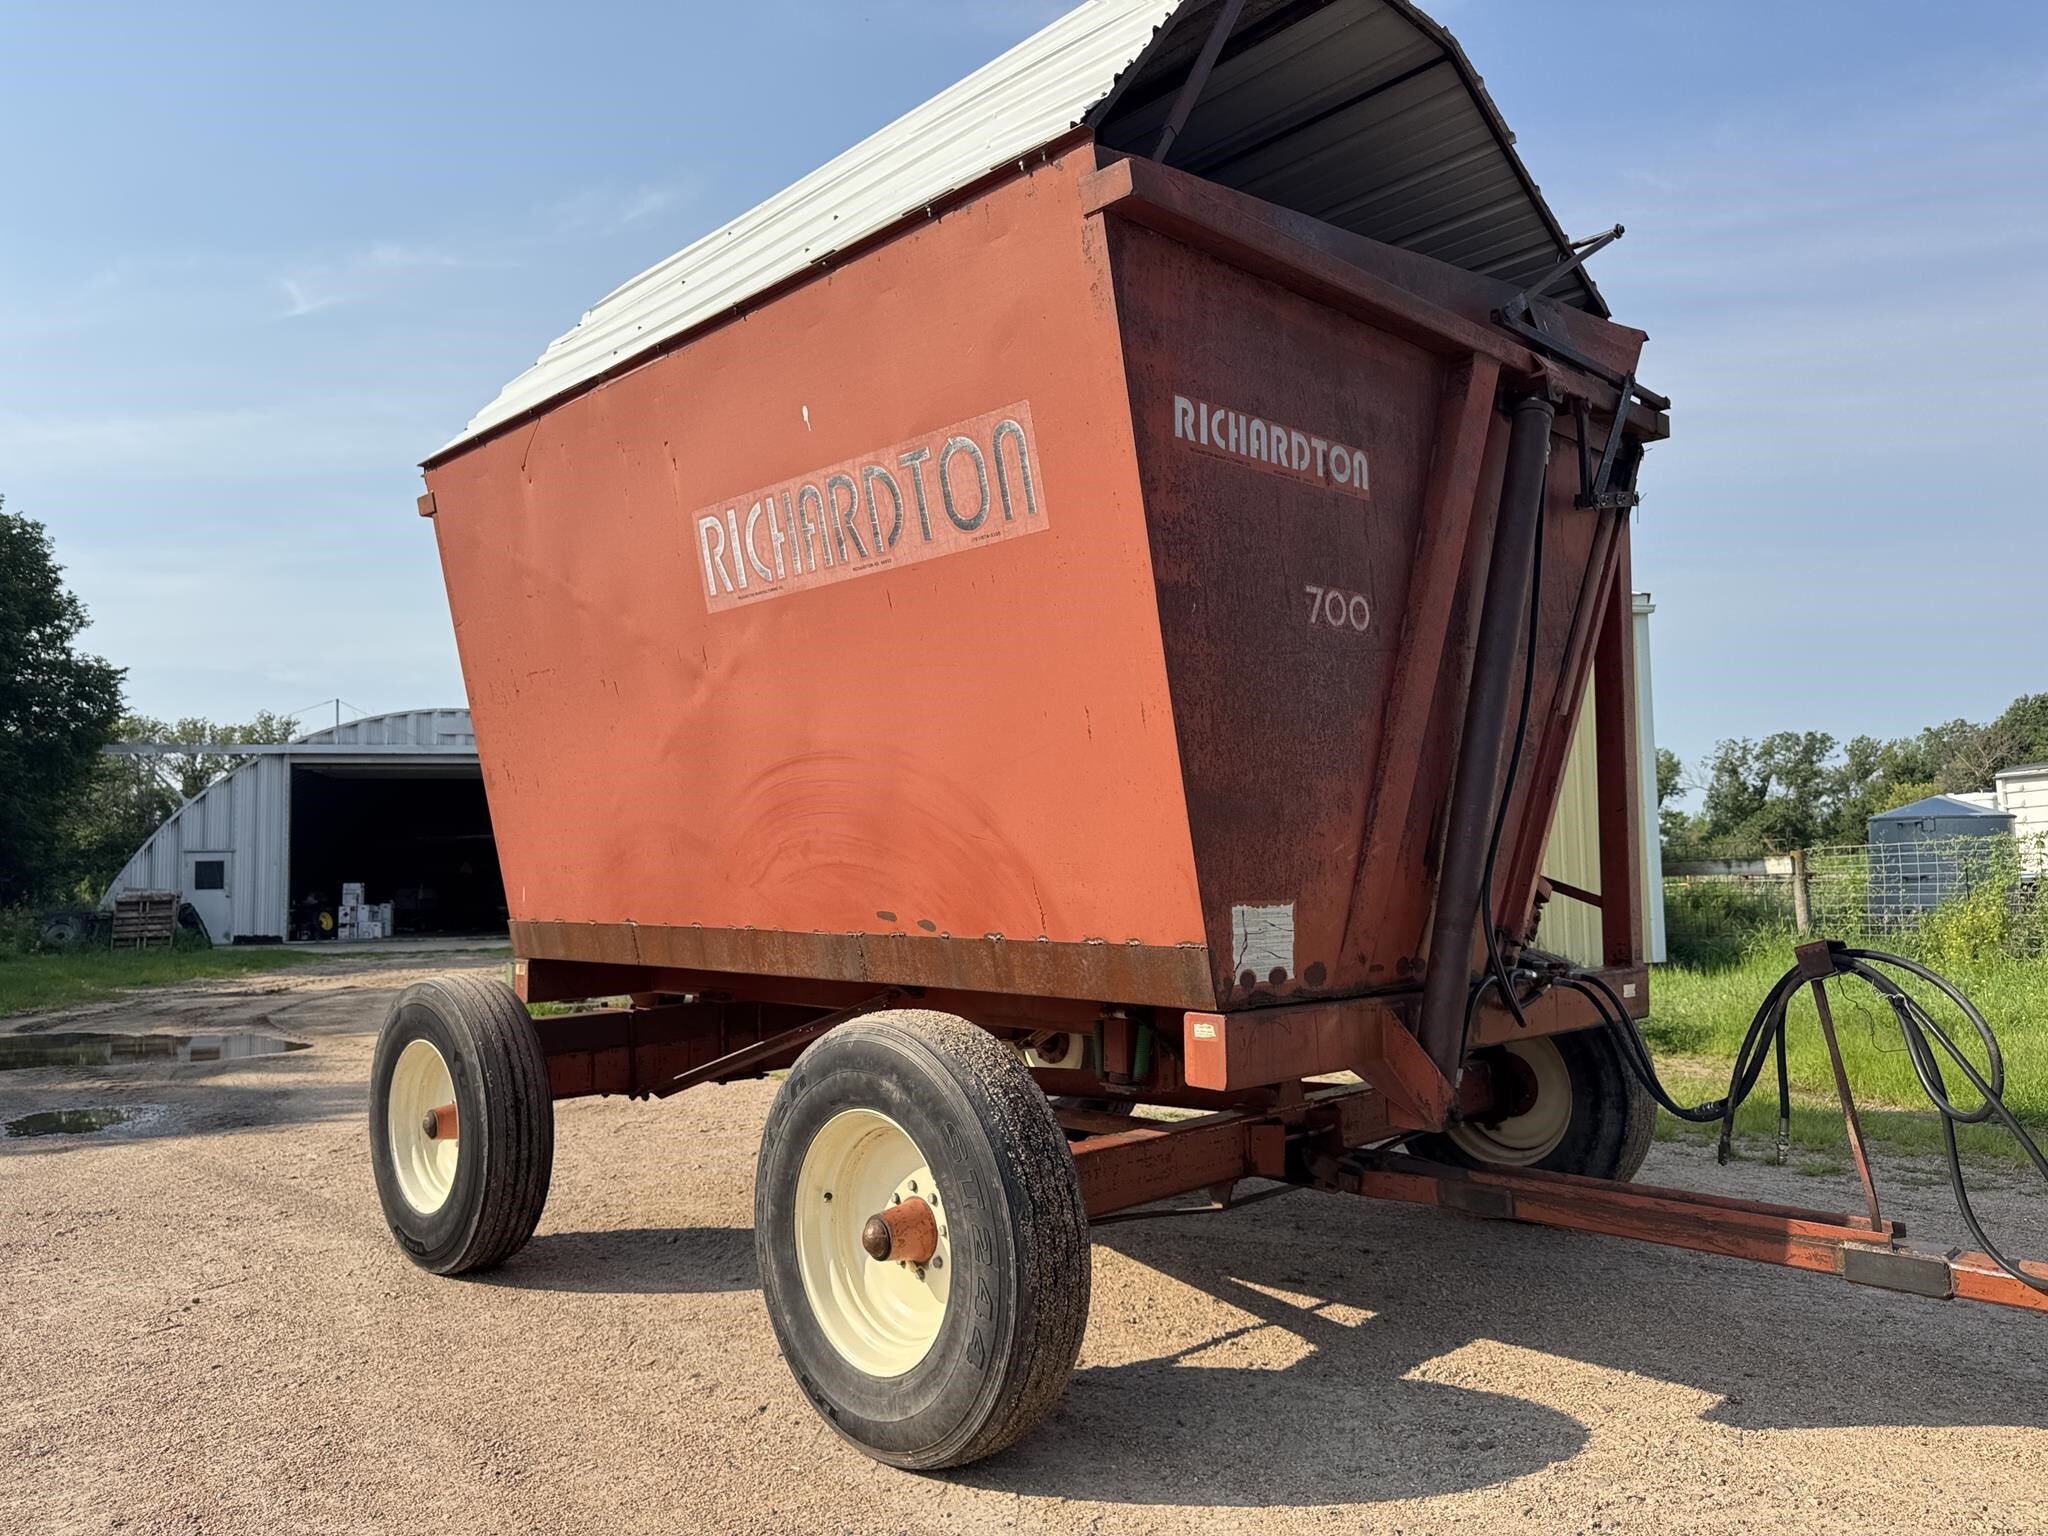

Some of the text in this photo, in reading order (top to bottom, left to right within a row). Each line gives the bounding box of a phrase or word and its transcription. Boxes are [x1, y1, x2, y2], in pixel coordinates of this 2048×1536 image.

[1174, 394, 1369, 491] RICHARDTON
[698, 418, 1037, 597] RICHARDTON
[1305, 584, 1370, 632] 700
